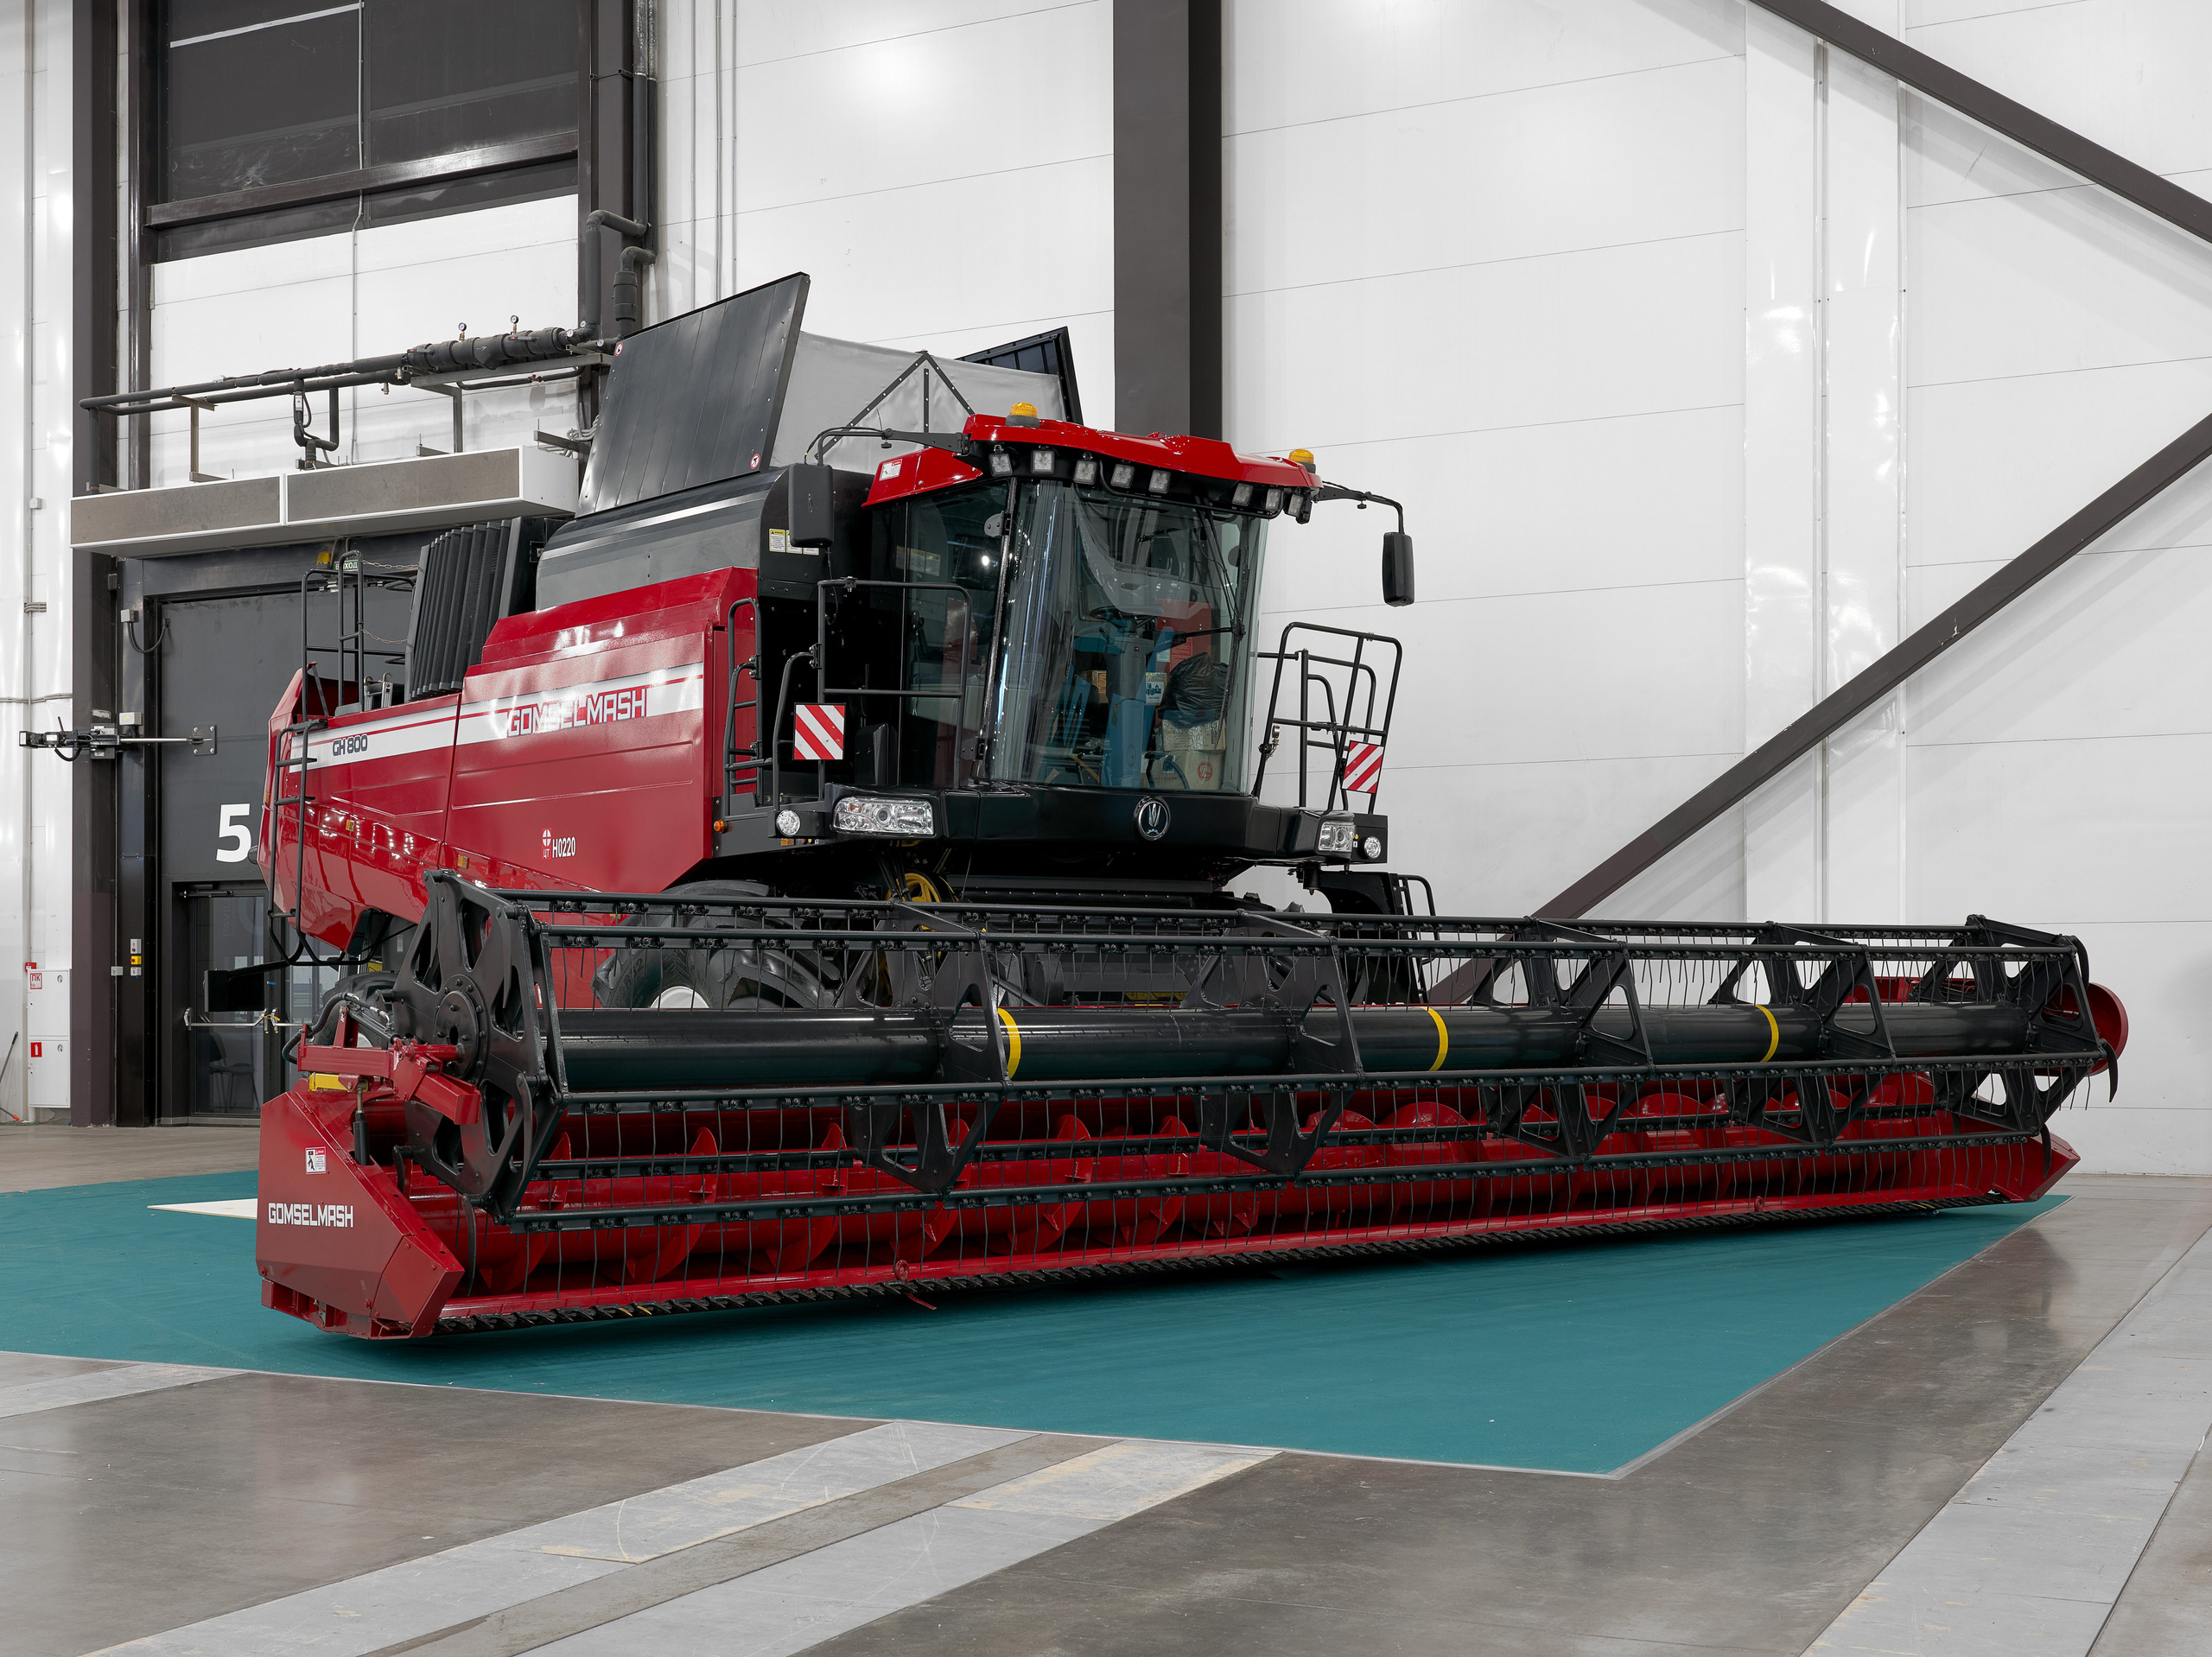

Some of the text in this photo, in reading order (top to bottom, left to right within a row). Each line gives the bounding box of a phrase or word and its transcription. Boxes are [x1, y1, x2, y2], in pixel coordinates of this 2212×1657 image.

[507, 688, 647, 738] GOMSELMASH
[333, 734, 368, 756] GH 800
[216, 803, 252, 863] 5
[268, 1203, 354, 1228] GOMSELMASH
